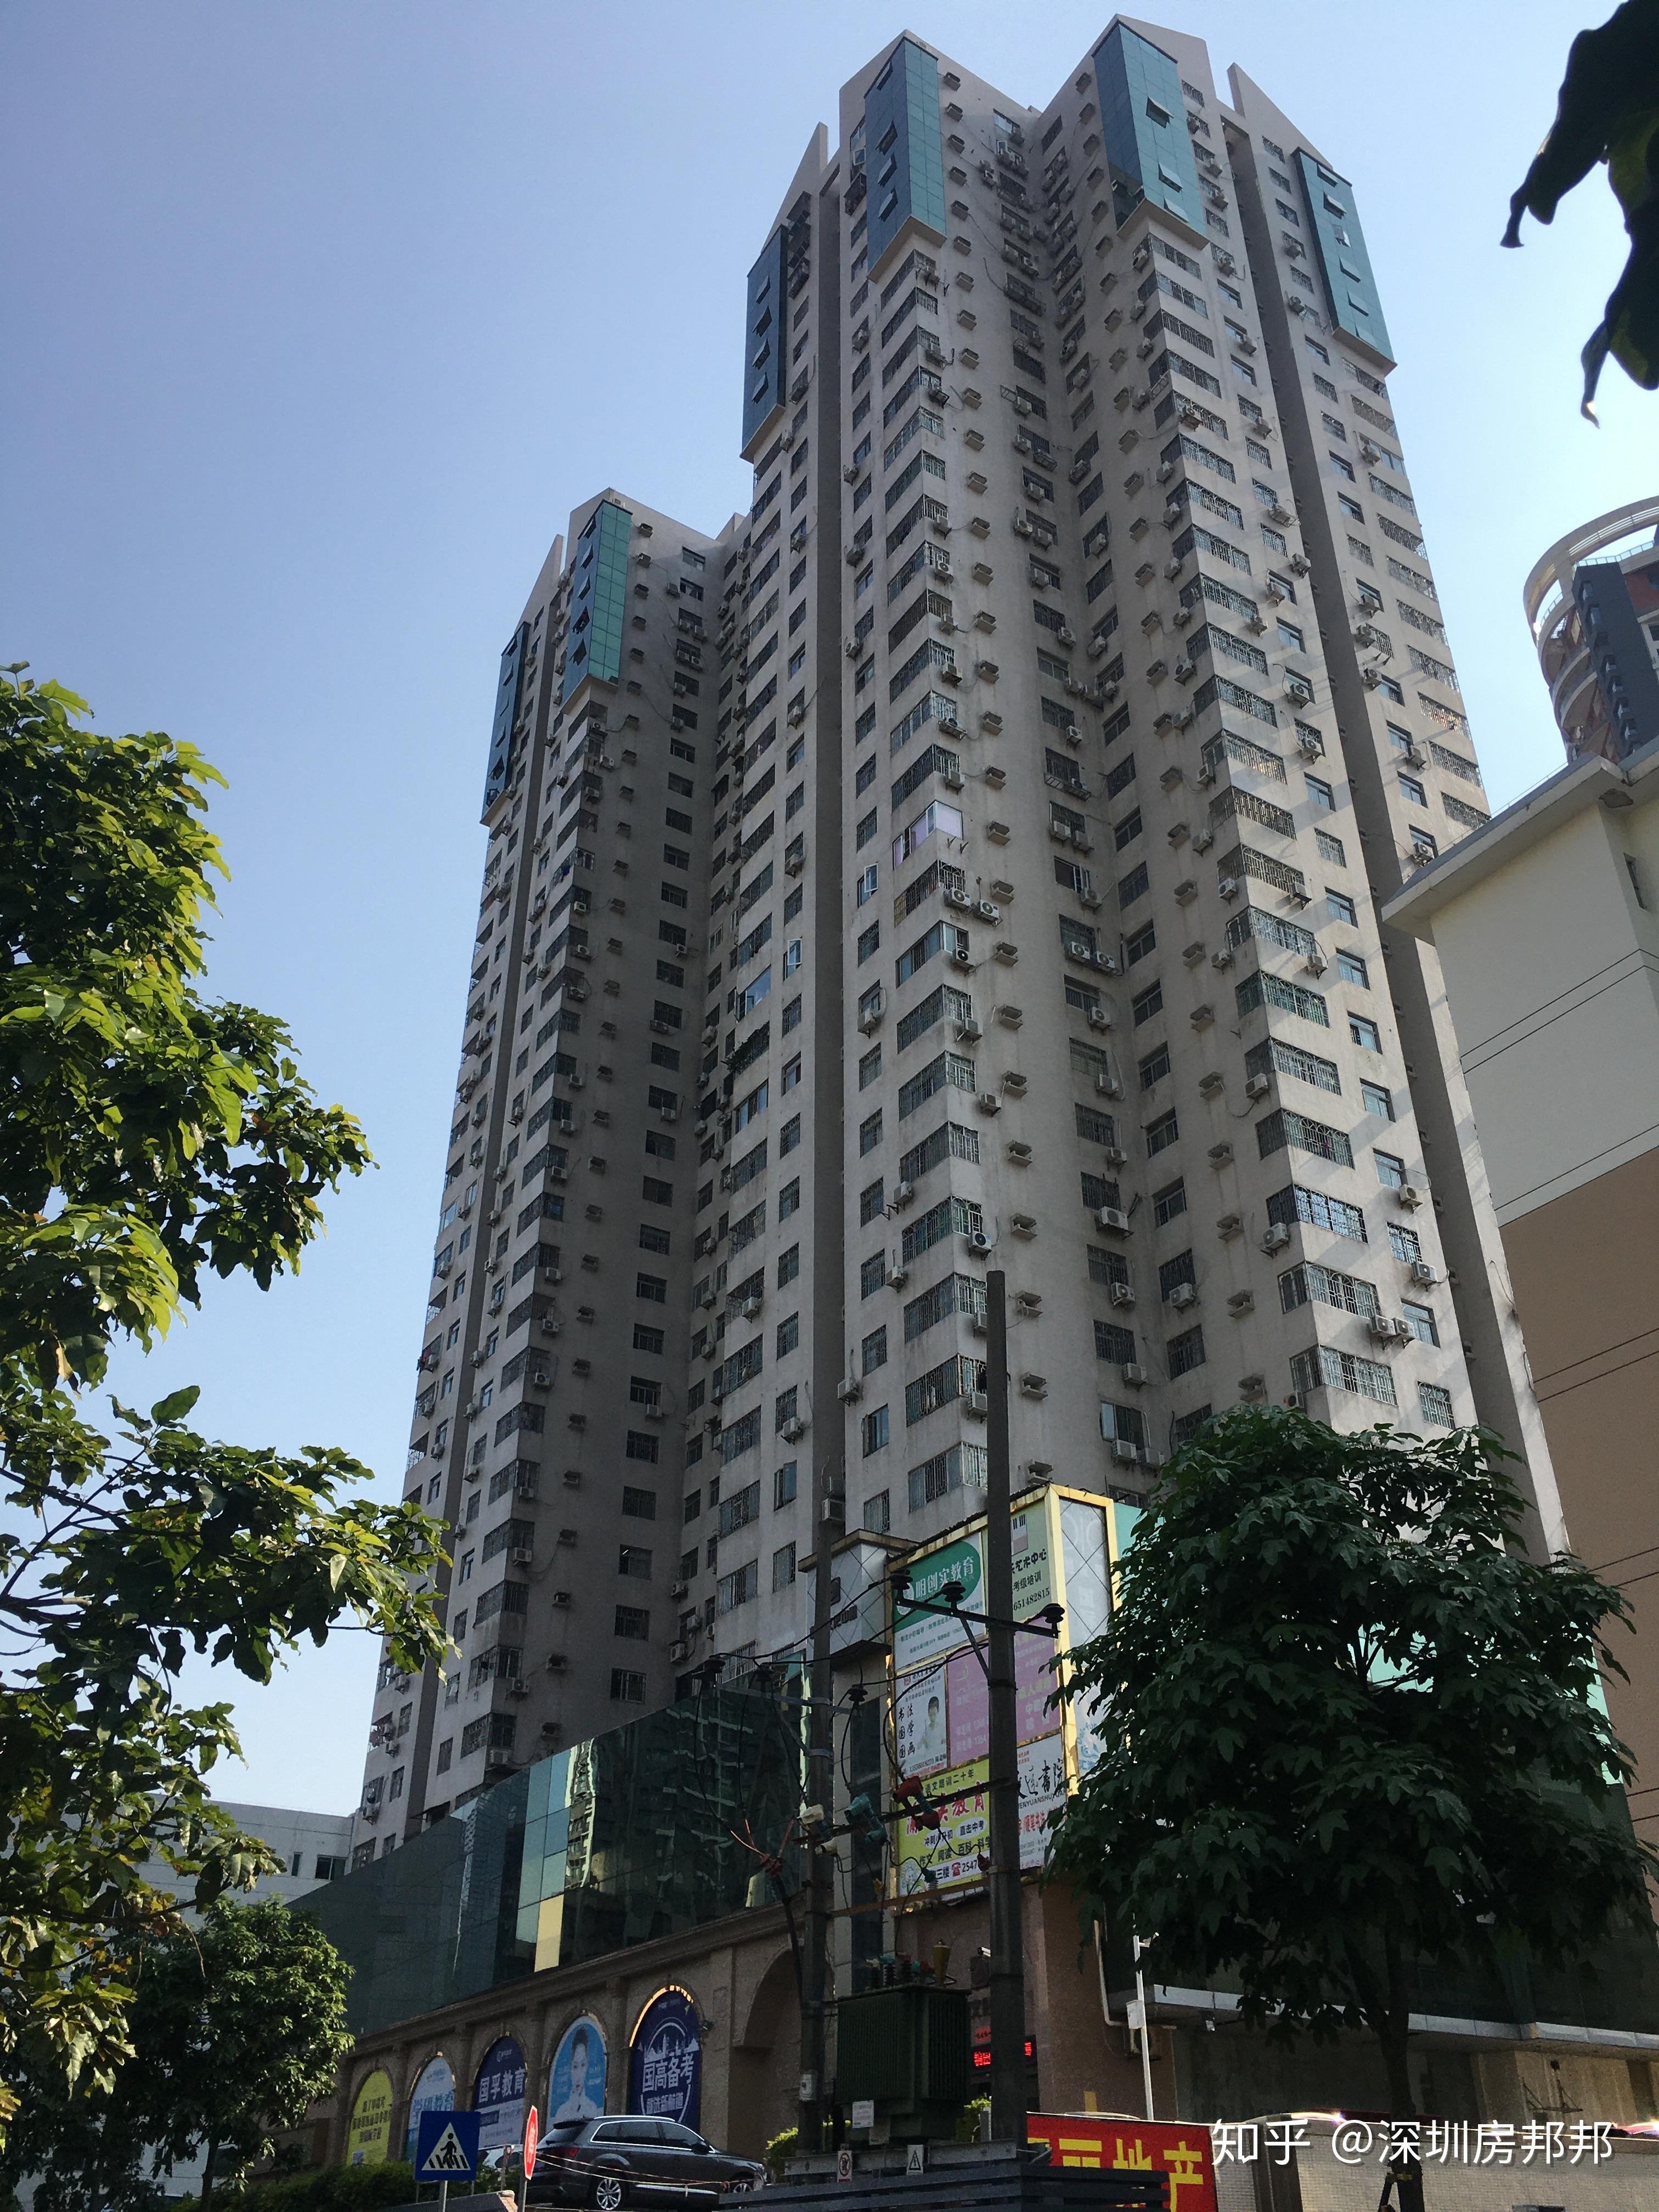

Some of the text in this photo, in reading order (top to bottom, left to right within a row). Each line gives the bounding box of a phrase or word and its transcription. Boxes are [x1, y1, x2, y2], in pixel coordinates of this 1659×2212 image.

[960, 1820, 985, 1835] 直击中考
[642, 2053, 694, 2092] 国高备考
